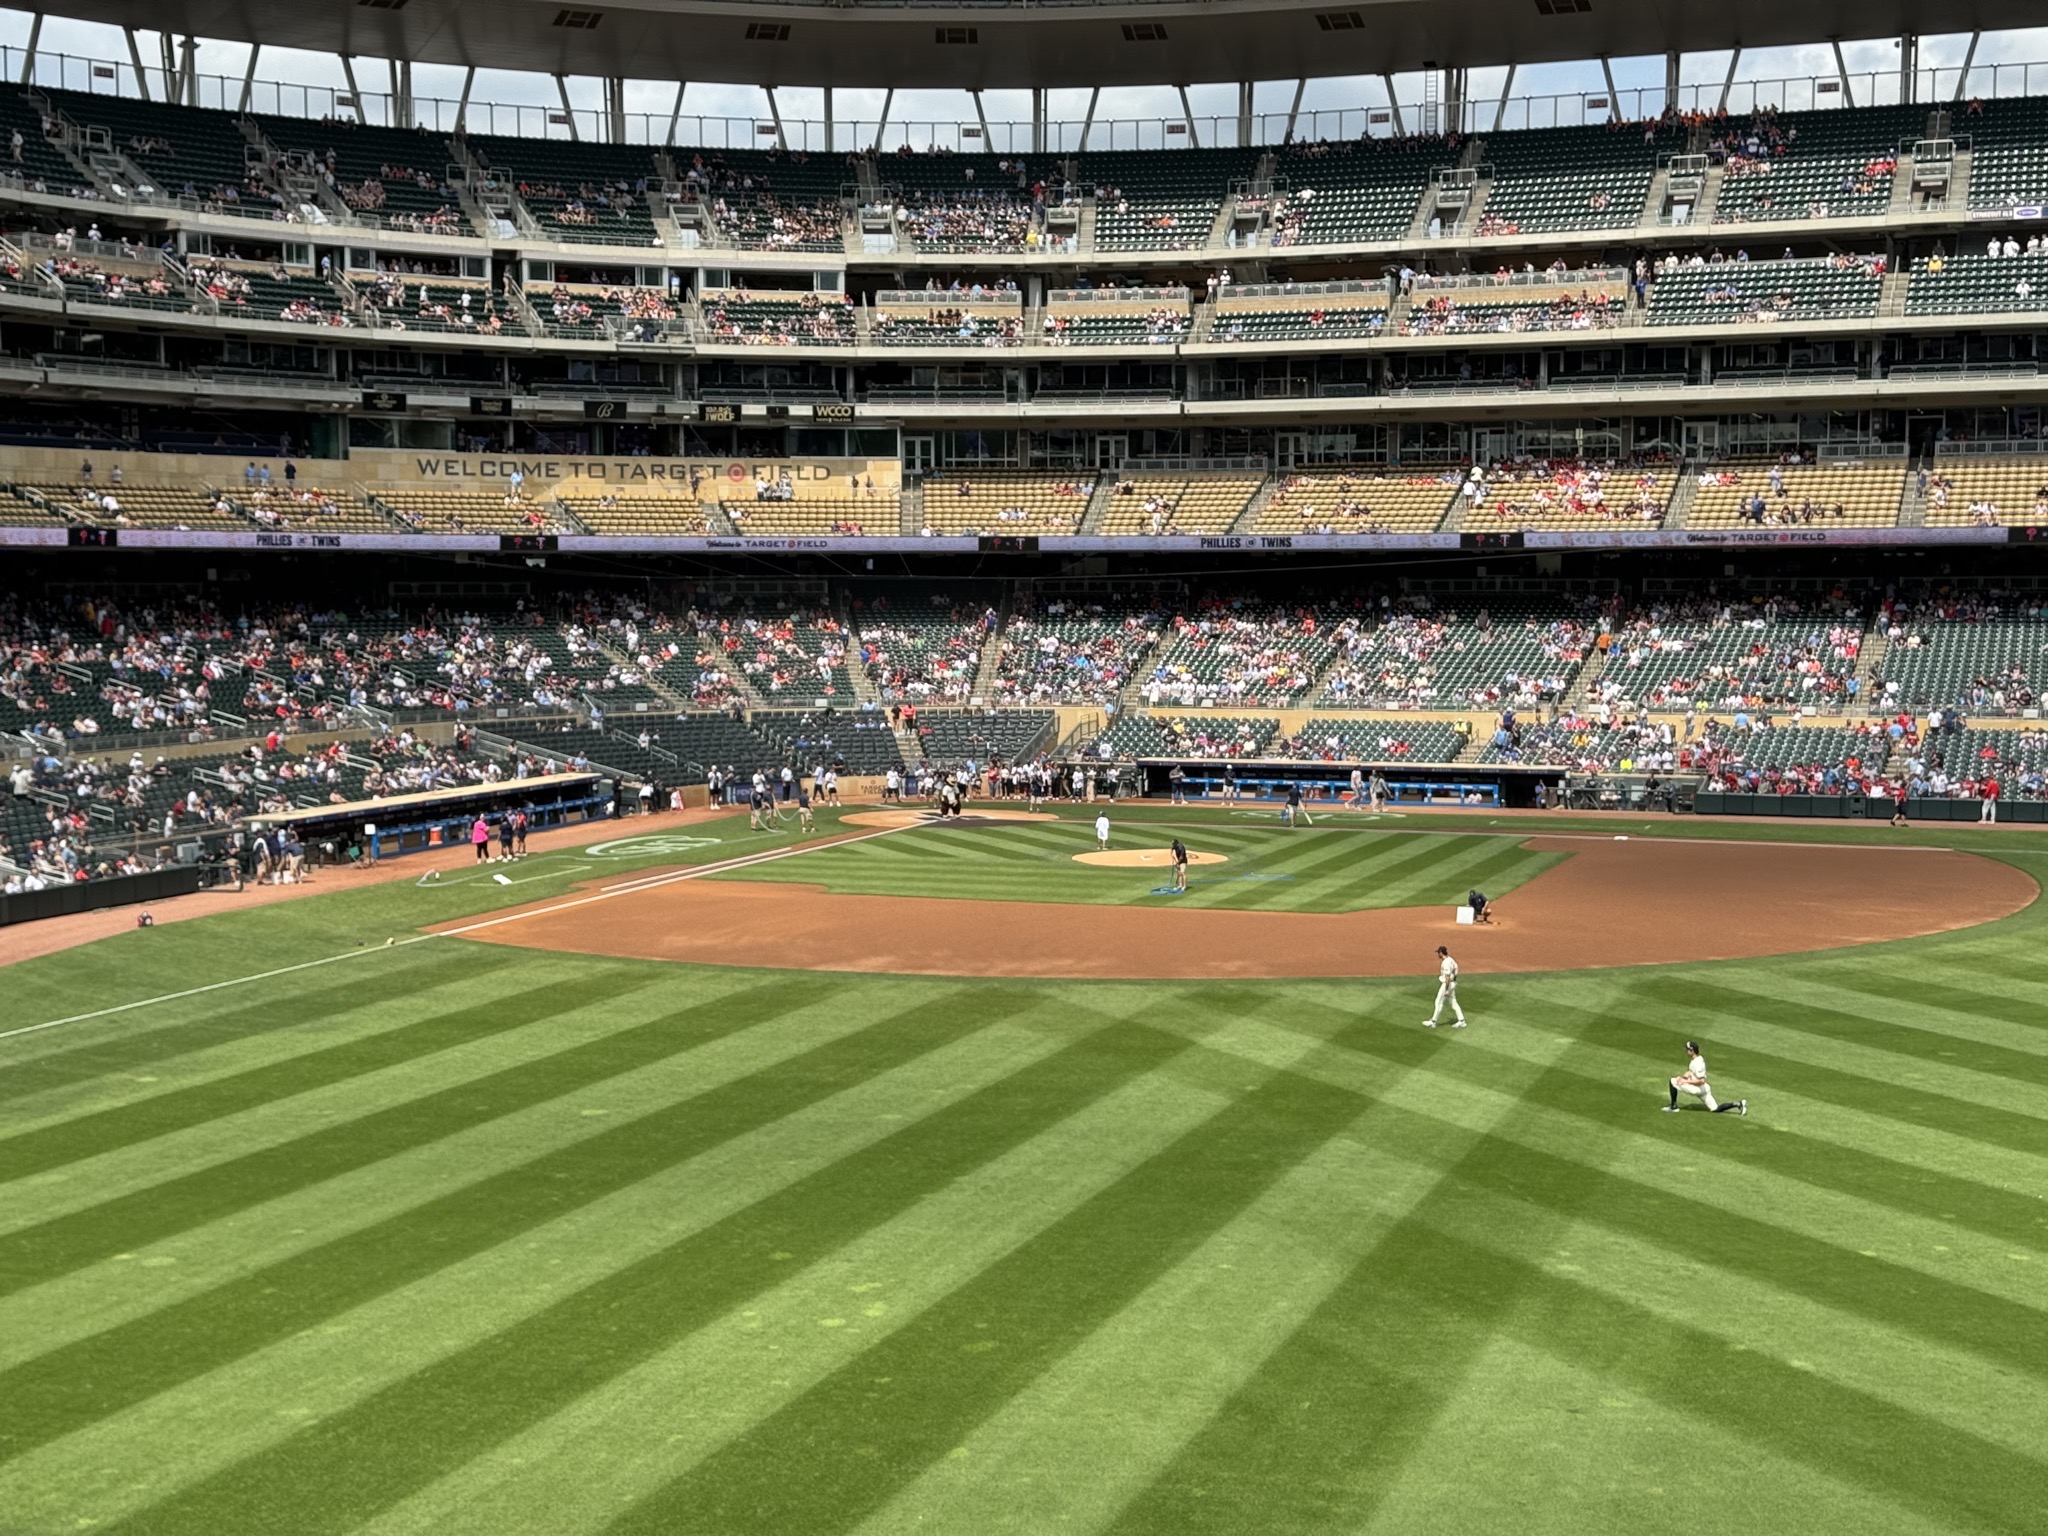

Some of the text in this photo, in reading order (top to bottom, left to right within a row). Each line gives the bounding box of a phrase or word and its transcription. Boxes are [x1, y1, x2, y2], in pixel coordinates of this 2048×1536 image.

[816, 406, 852, 416] WCCO
[710, 412, 735, 421] WOLF
[416, 458, 831, 481] WELCOME TO TARGET FIELD
[256, 534, 292, 546] PHILLIES
[311, 535, 341, 547] TWINS
[1731, 533, 1778, 541] TARGET
[1790, 533, 1826, 541] FIELD
[744, 540, 786, 548] TARGET
[797, 540, 828, 548] FIELD
[1200, 537, 1241, 548] PHILLIES
[1260, 537, 1292, 548] TWINS
